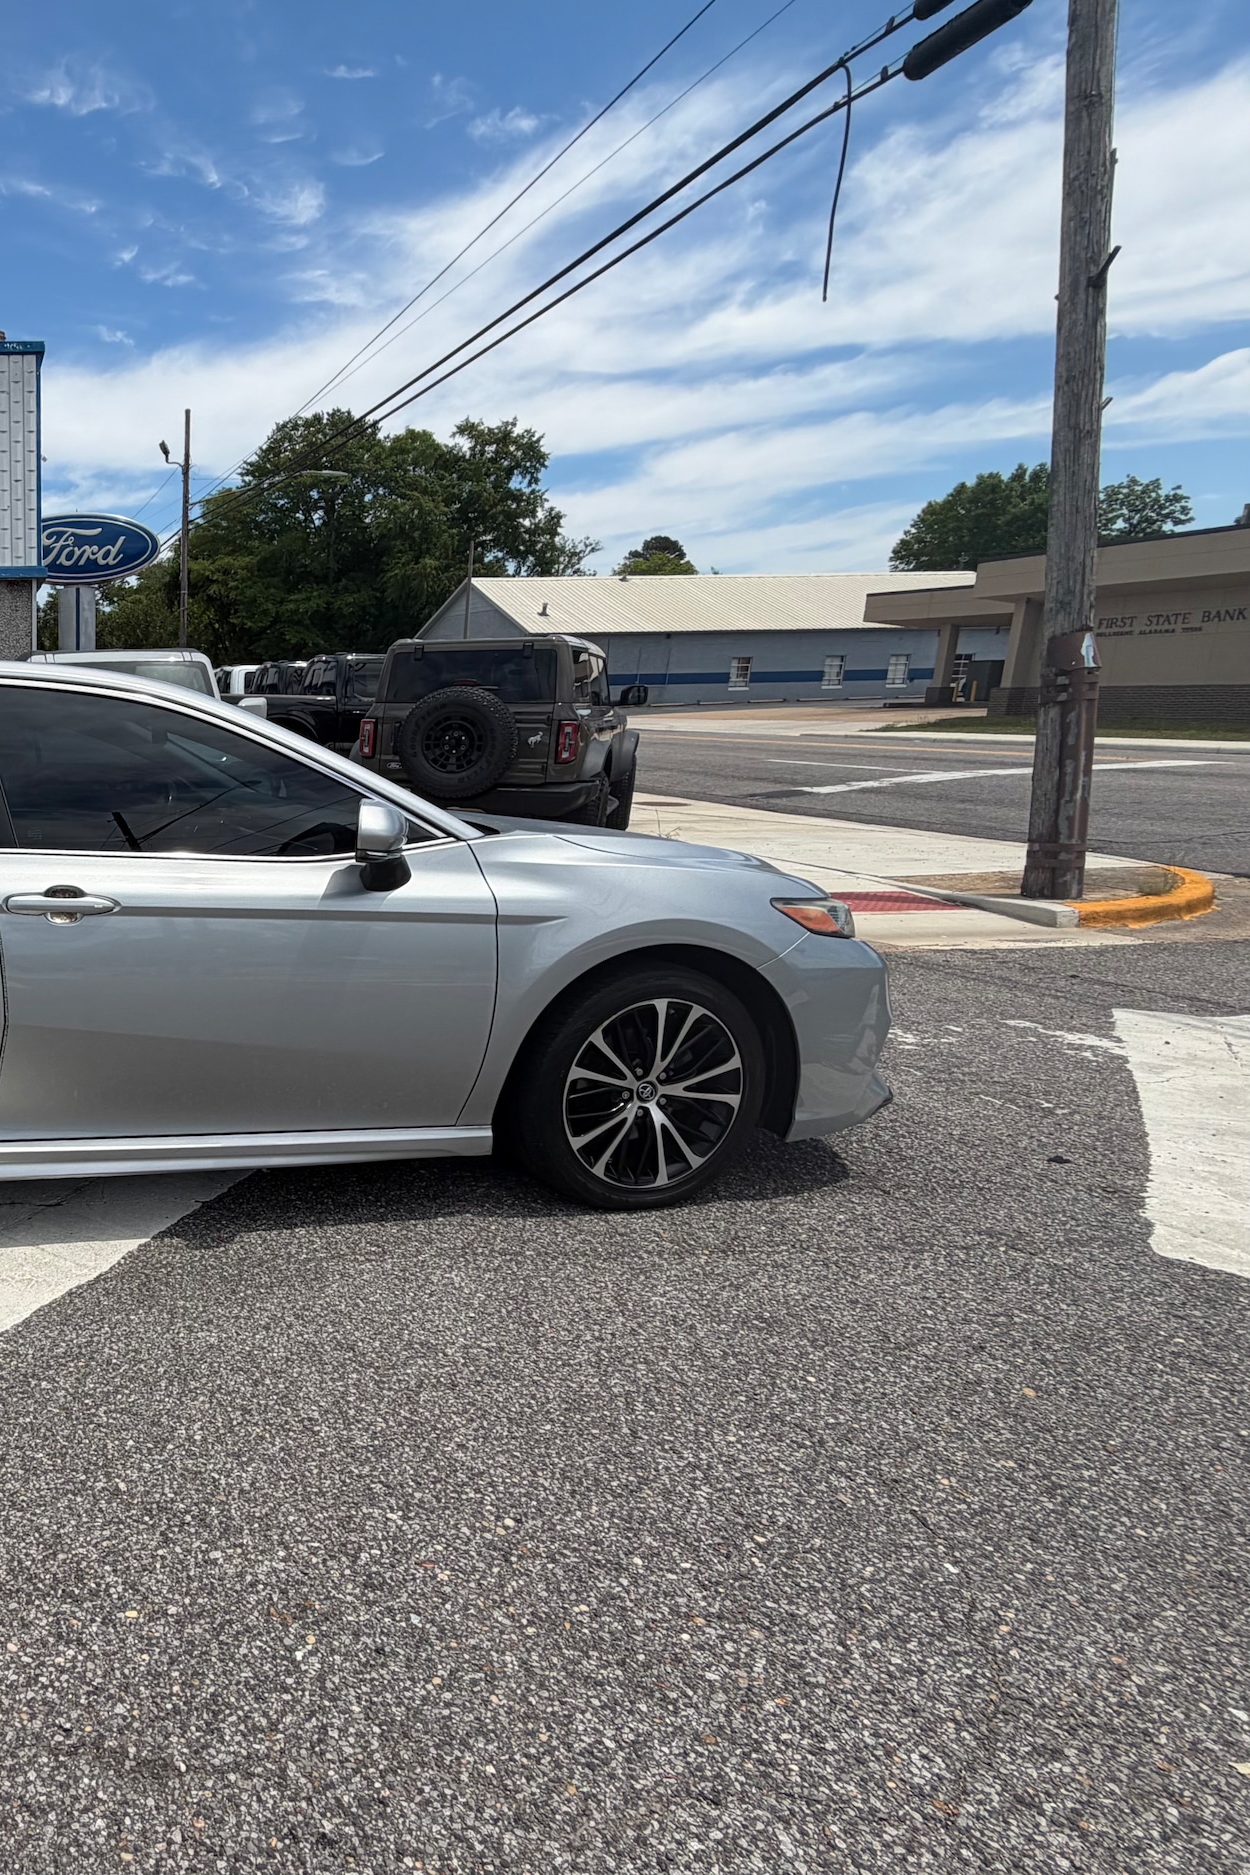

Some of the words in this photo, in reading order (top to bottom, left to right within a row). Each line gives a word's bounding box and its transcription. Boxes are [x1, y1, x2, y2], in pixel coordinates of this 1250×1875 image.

[42, 527, 126, 567] Ford
[1097, 616, 1137, 630] FIRST
[1144, 612, 1192, 627] STATE
[1201, 607, 1247, 623] BANK
